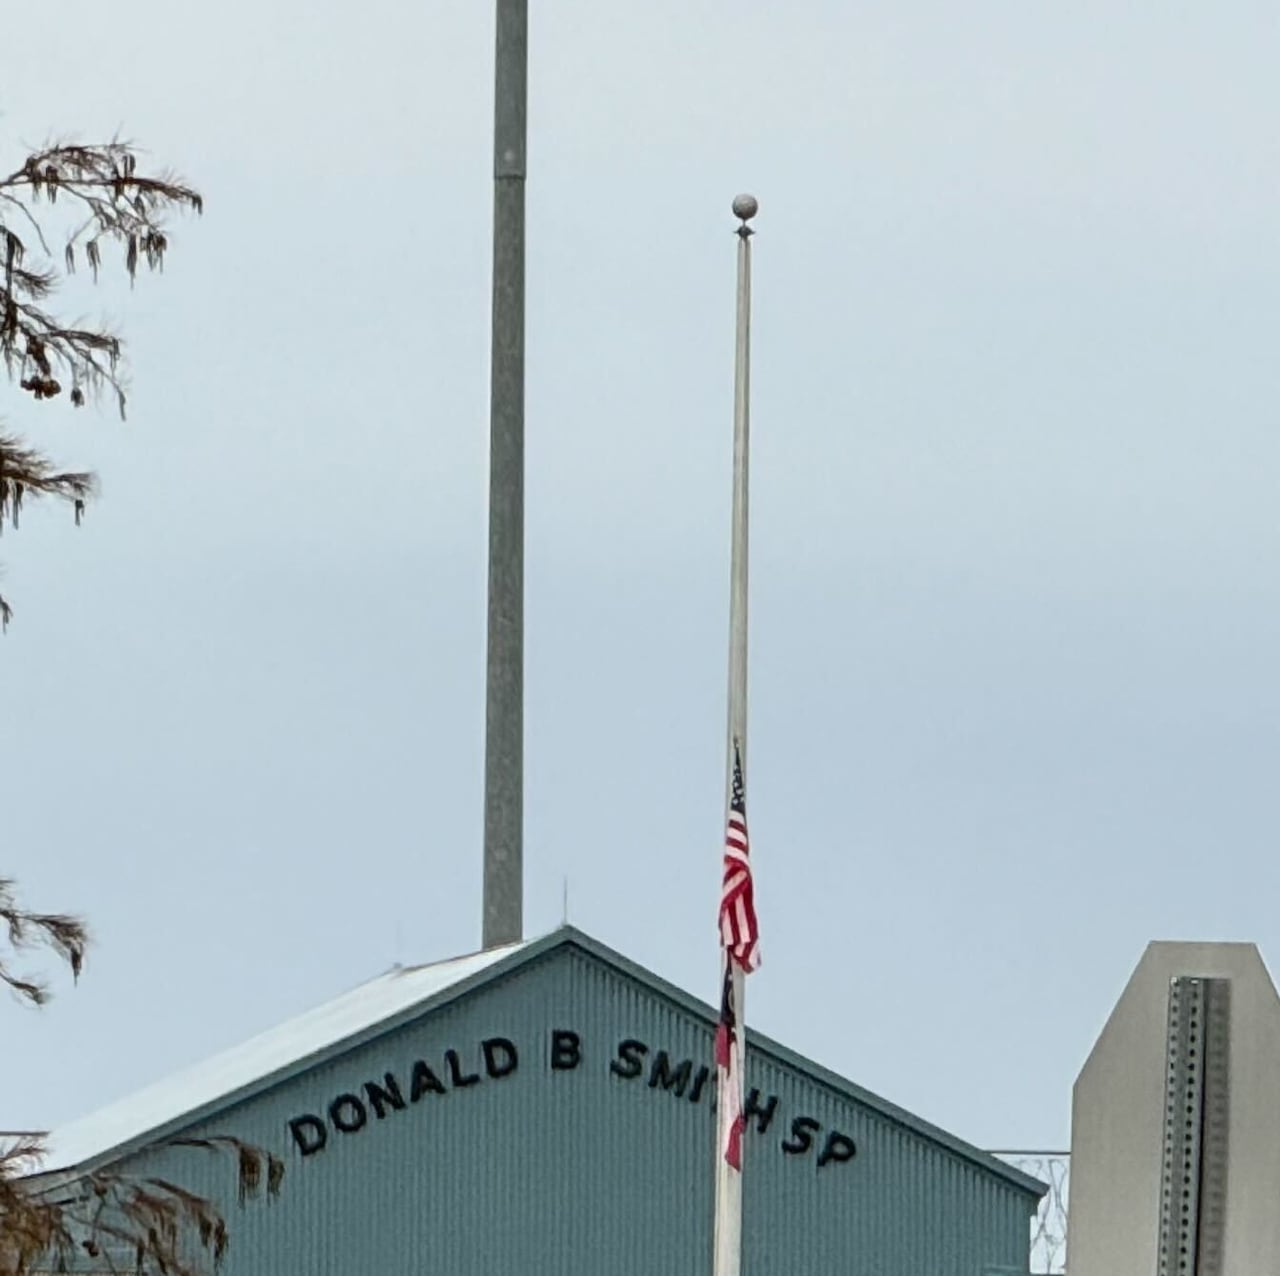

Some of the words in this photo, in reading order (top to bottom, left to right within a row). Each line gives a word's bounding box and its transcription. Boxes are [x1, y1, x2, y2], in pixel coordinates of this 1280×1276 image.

[289, 1037, 518, 1156] DONALD
[551, 1029, 582, 1070] B
[610, 1039, 778, 1135] SMIH
[782, 1116, 857, 1168] SP
